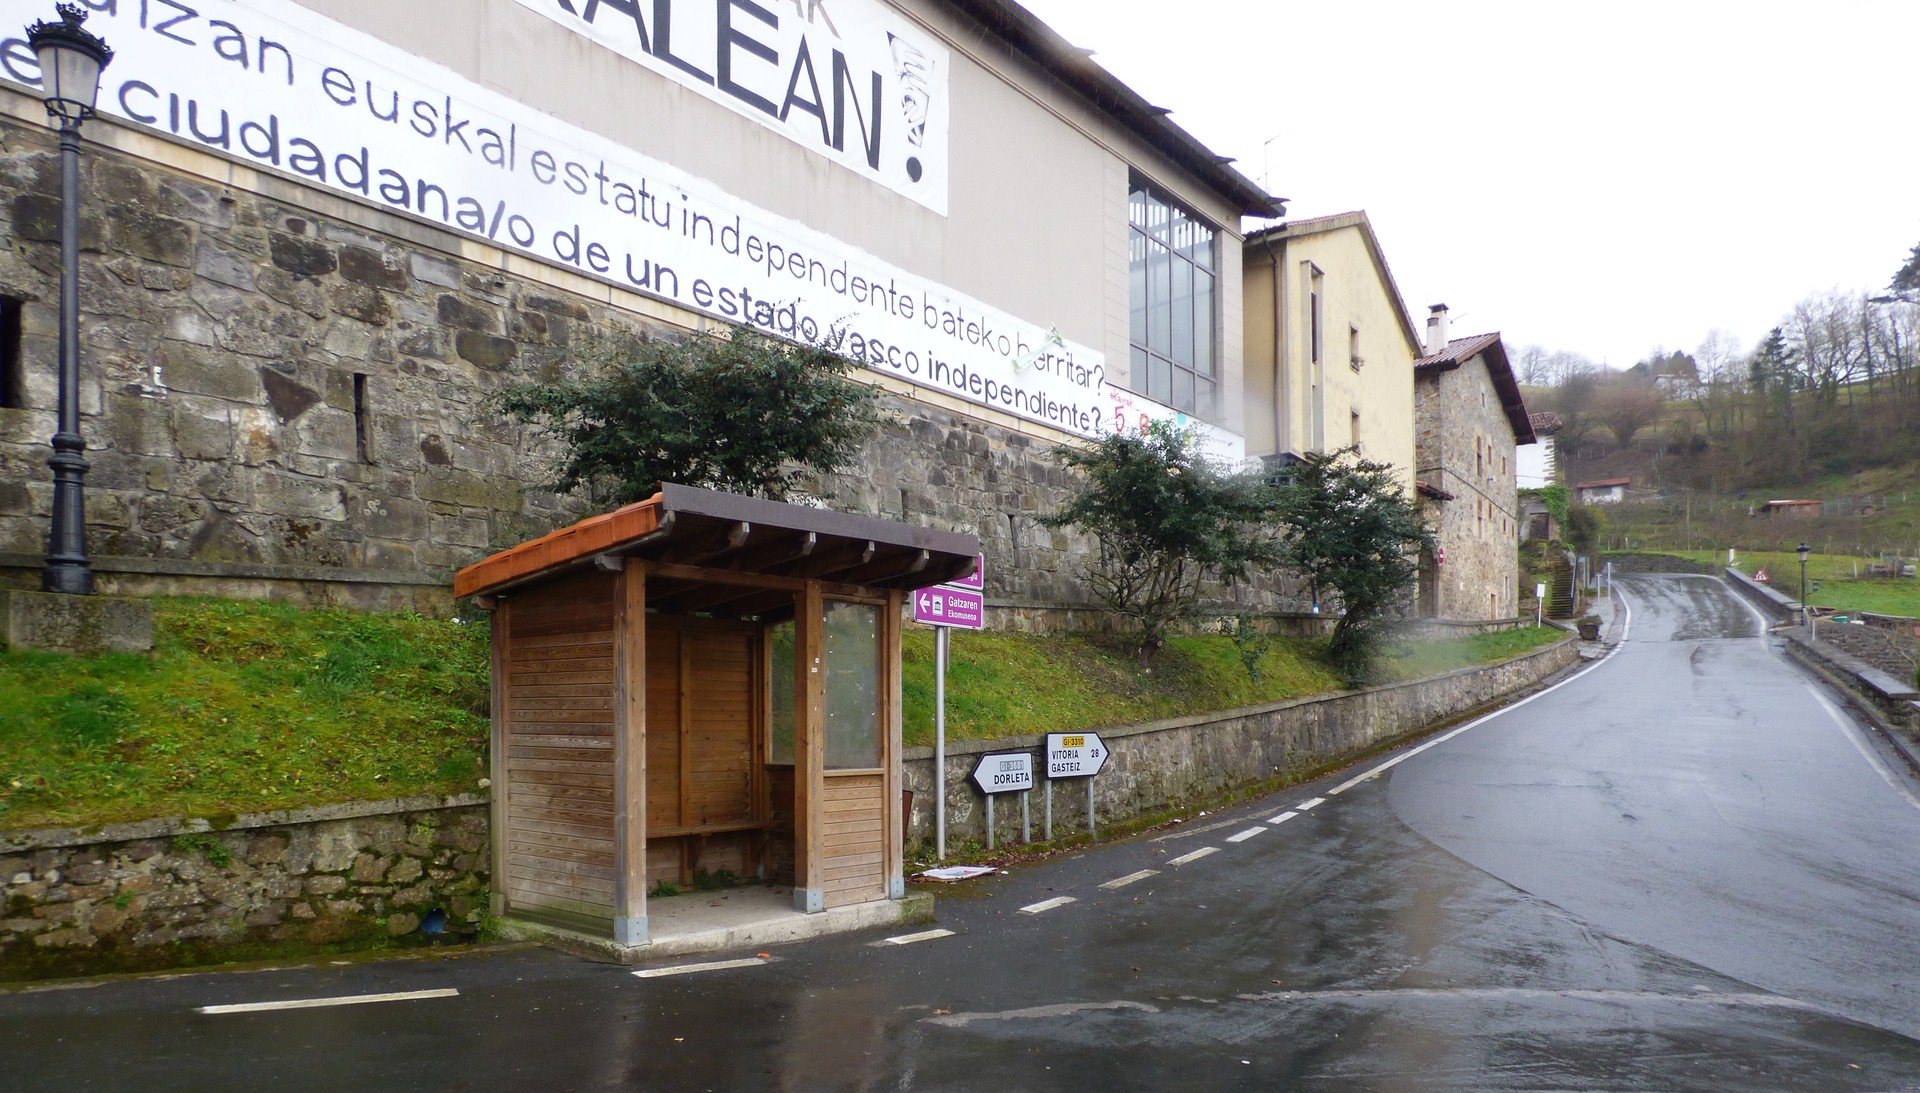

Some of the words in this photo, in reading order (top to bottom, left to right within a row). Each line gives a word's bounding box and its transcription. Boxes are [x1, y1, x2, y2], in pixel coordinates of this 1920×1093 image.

[321, 66, 516, 172] euskal
[531, 149, 670, 230] estatu
[681, 193, 915, 320] independente
[923, 291, 1011, 357] bateko
[1016, 330, 1105, 397] herritar?
[118, 79, 535, 248] ciudadana/o
[553, 224, 611, 273] de
[625, 251, 679, 298] un
[692, 278, 819, 342] estado
[829, 324, 919, 375] vasco
[929, 350, 1101, 434] independiente?
[1114, 404, 1126, 433] 5
[948, 595, 979, 611] Gatzaren
[947, 608, 978, 622] Ekomuseoa
[1062, 737, 1085, 747] GI-3310
[1051, 750, 1079, 760] VITORIA
[1090, 748, 1100, 758] 28
[1051, 761, 1081, 773] GASTEIZ
[993, 772, 1030, 785] DORLETA
